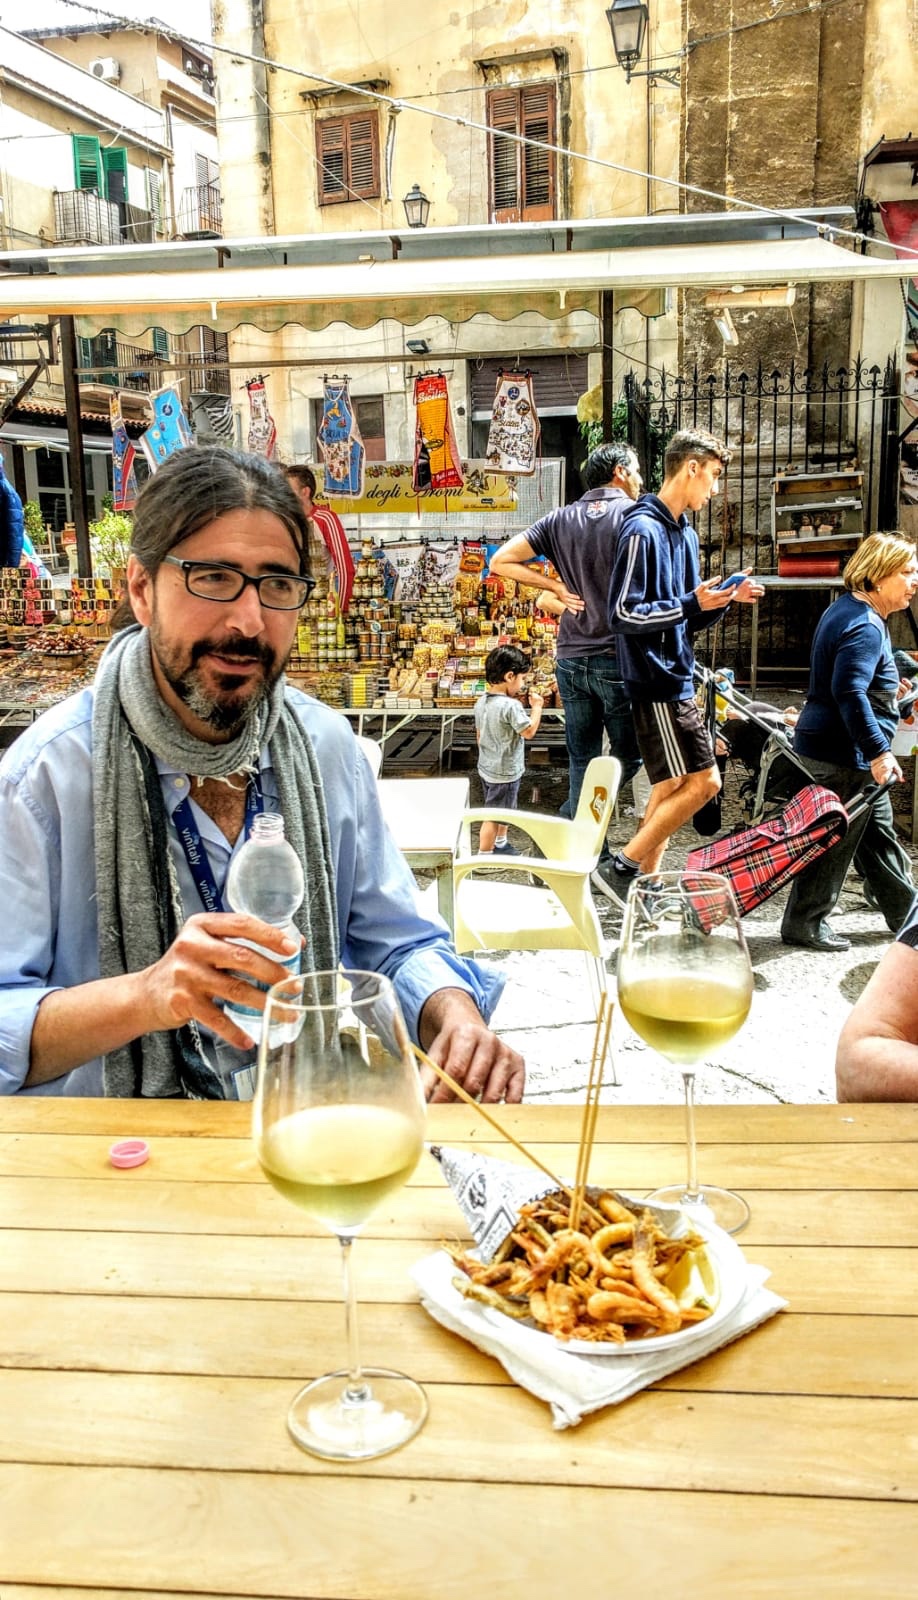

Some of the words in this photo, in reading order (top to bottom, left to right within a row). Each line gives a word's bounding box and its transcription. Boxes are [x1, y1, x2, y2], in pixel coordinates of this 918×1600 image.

[366, 483, 401, 507] degli
[182, 828, 201, 865] vinitaly
[199, 879, 218, 913] vinital
